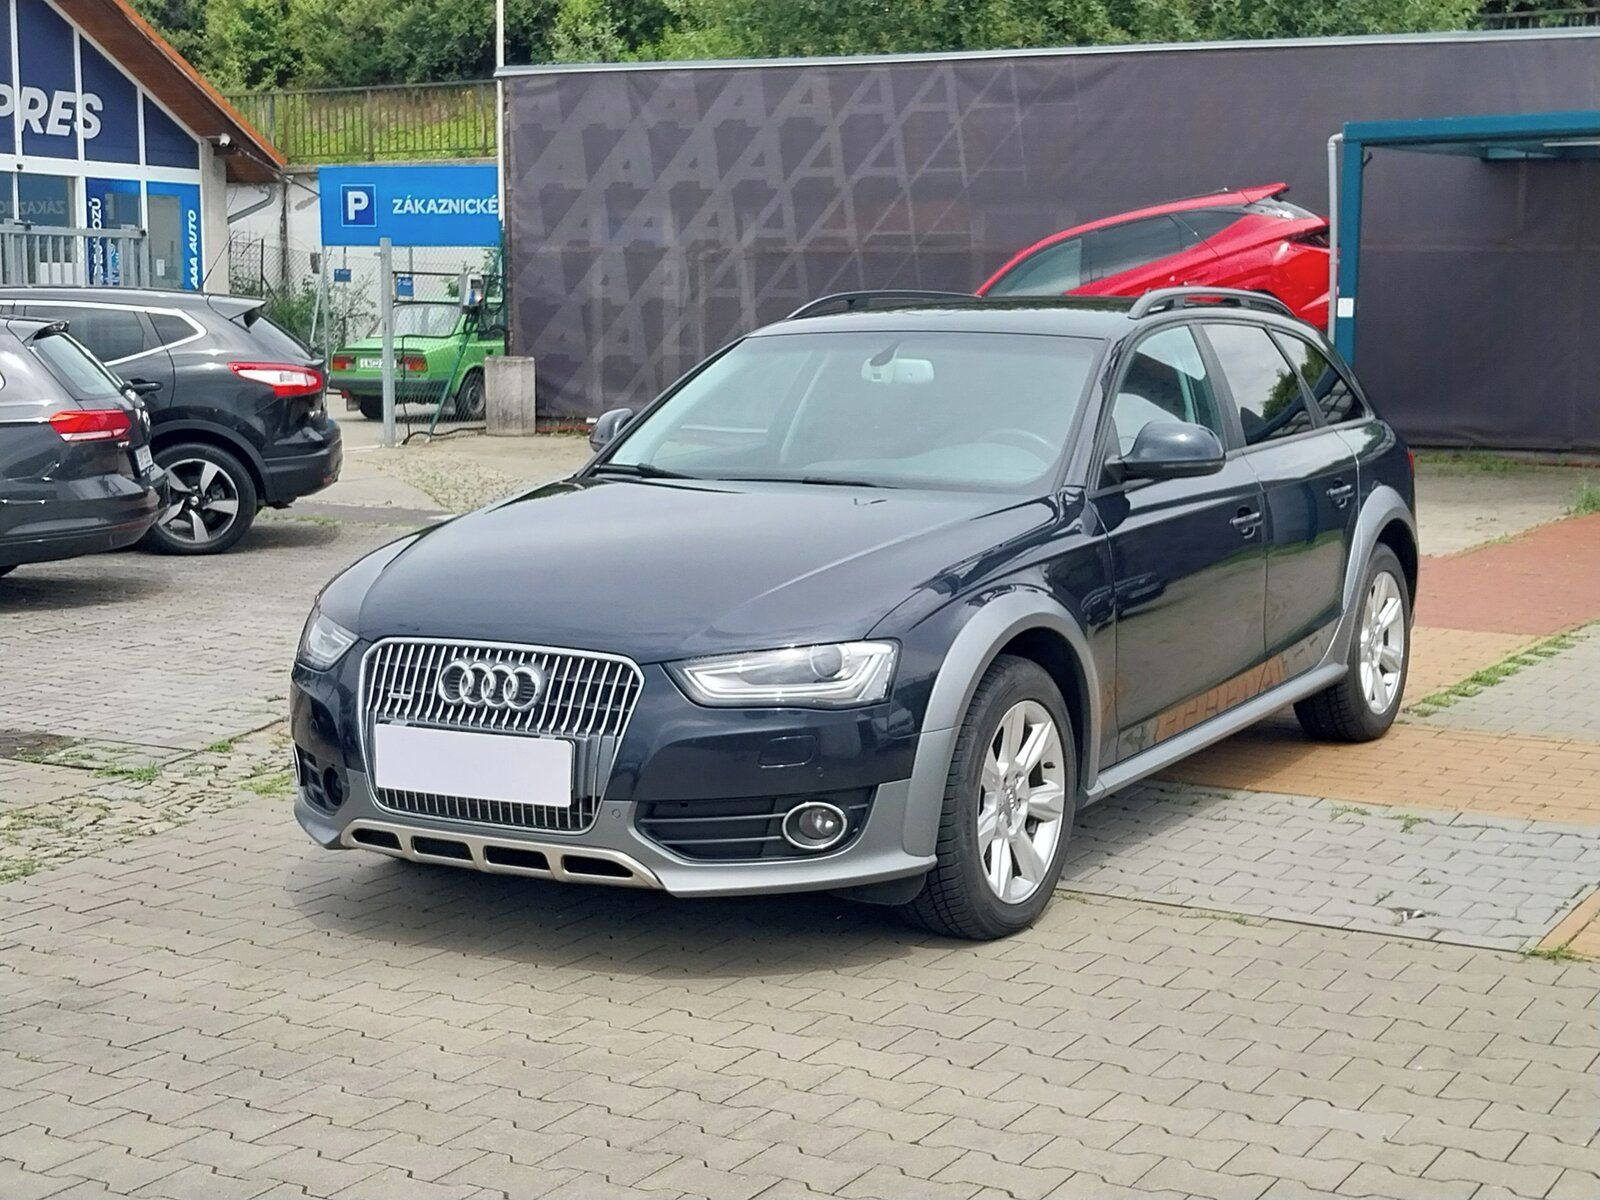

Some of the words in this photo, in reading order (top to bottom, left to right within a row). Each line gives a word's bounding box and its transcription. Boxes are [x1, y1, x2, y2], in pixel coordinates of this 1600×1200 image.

[347, 190, 369, 221] P
[392, 194, 499, 215] ZÁKAZNICKÉ
[187, 209, 198, 256] AUTO
[190, 257, 199, 290] AAA
